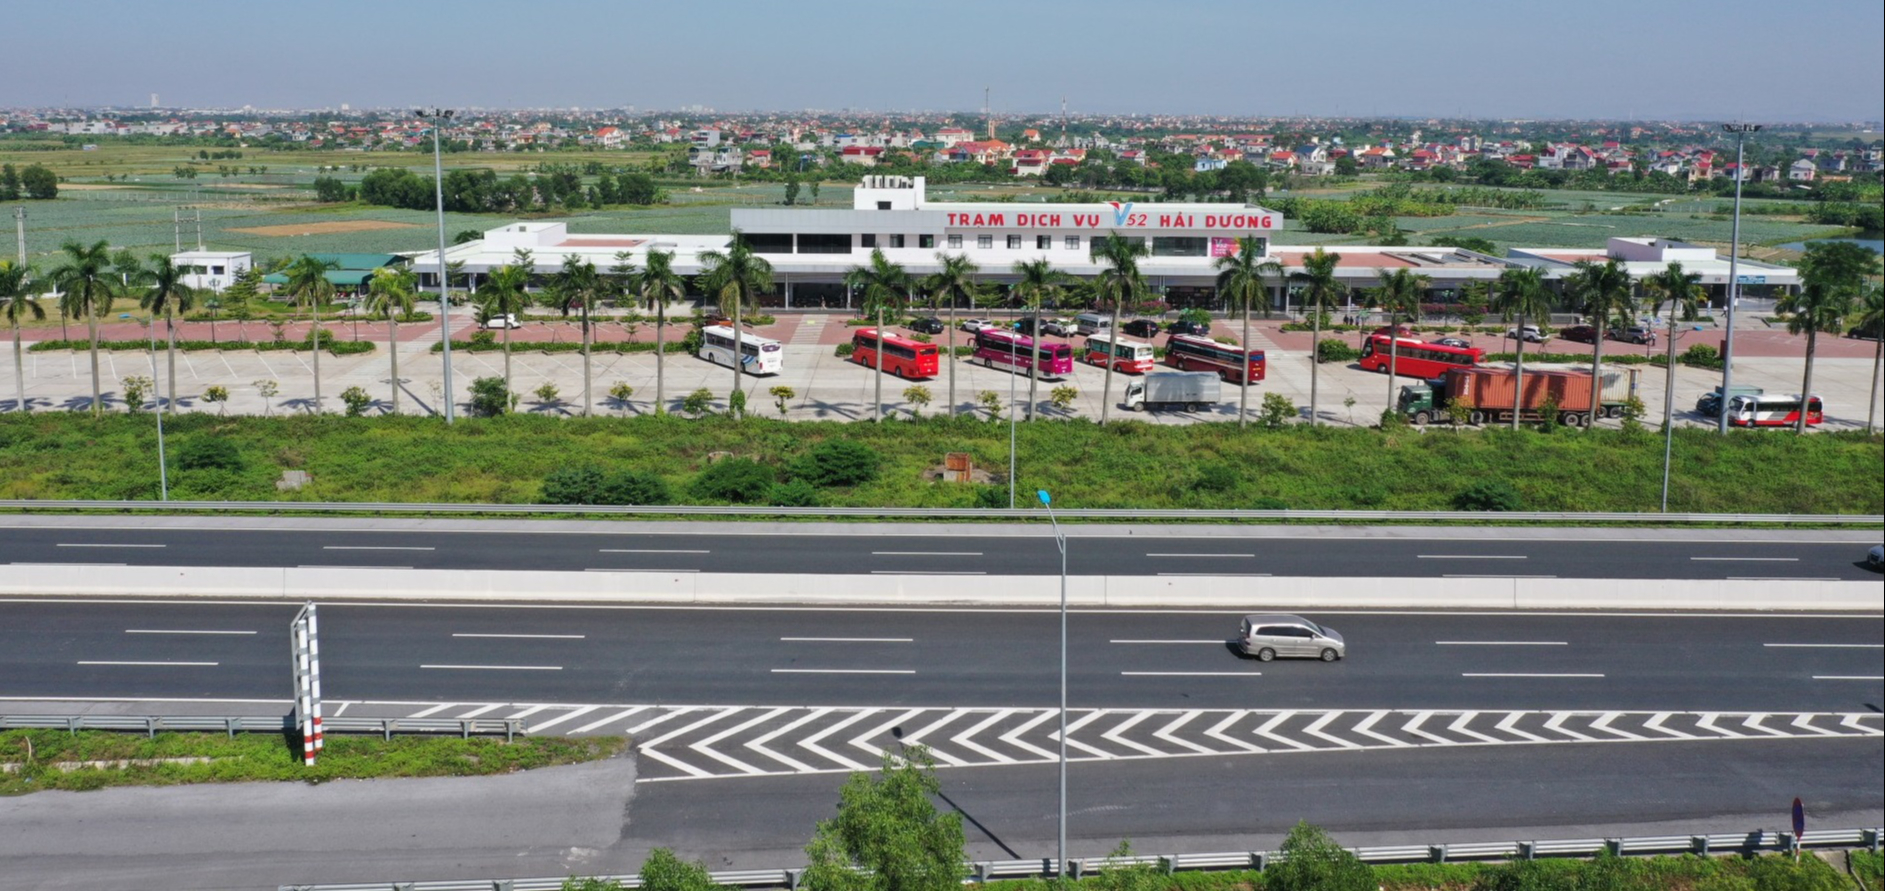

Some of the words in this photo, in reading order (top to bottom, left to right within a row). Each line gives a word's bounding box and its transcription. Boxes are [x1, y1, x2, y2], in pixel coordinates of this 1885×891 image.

[947, 213, 1004, 228] TRẠM
[1017, 214, 1060, 228] DỊCH
[1073, 214, 1100, 229] VỤ
[1159, 211, 1193, 227] HẢI
[1205, 214, 1272, 228] DƯƠNG
